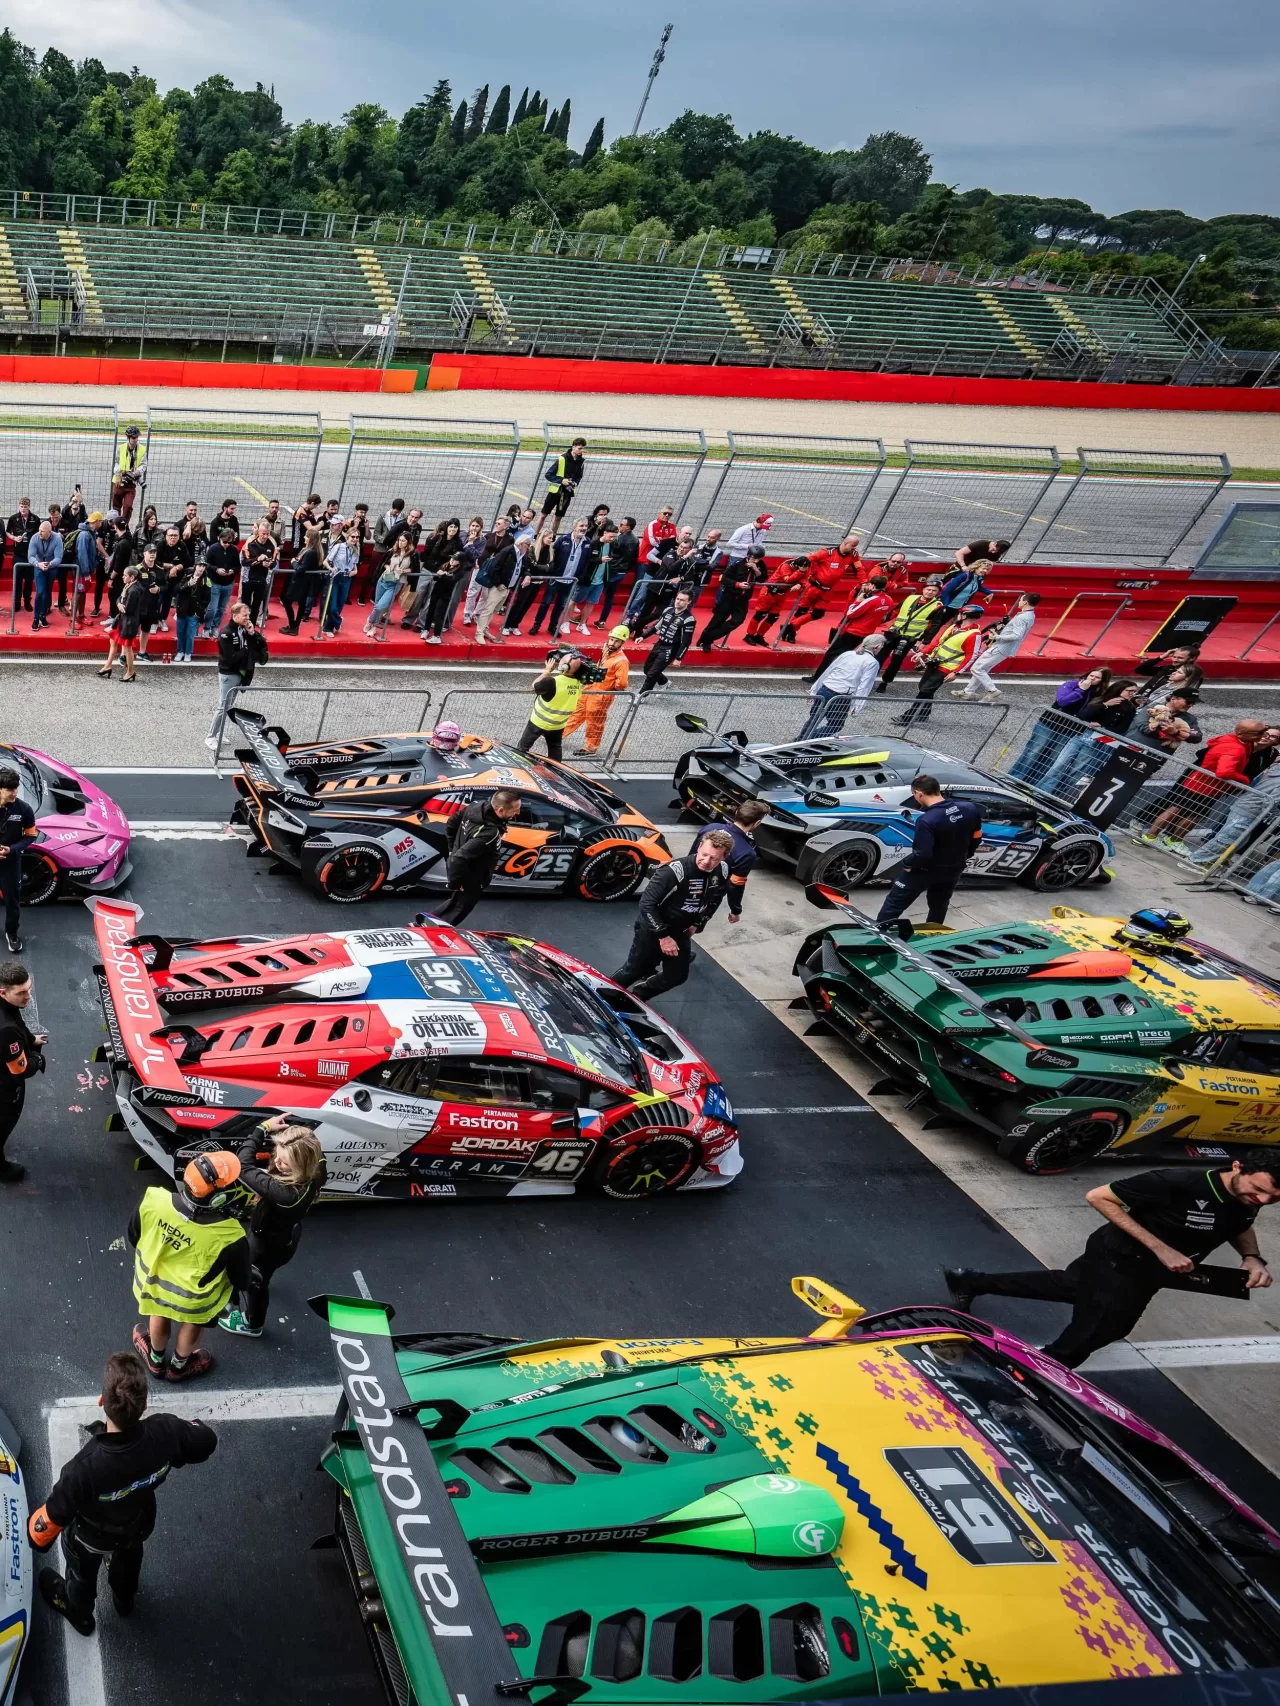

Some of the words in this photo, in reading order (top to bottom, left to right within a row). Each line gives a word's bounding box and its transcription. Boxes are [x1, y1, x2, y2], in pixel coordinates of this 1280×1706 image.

[288, 757, 319, 766] ROGER
[320, 754, 354, 764] DUBUIS
[792, 756, 822, 765] DUBUIS
[1088, 777, 1125, 817] 3
[393, 836, 415, 856] MS
[535, 854, 573, 873] 25
[997, 850, 1032, 868] 32
[68, 868, 98, 877] Fastron
[356, 929, 413, 943] ON-LINE
[95, 911, 153, 1020] randstad
[460, 932, 519, 987] DUBUIS
[421, 961, 463, 996] 46
[985, 965, 1031, 977] DUBUIS
[165, 990, 213, 1003] ROGER
[214, 986, 264, 999] DUBUIS
[97, 974, 128, 1062] XEKUTORBRNO.CZ
[517, 990, 563, 1052] ROGER
[412, 1022, 480, 1039] ON-LINE
[1136, 1030, 1171, 1038] breco
[1041, 1054, 1072, 1068] macron
[183, 1075, 220, 1090] KARNA
[573, 1067, 628, 1093] EXEKUTORBRNO.CZ
[1199, 1078, 1261, 1096] Fastron
[1225, 1075, 1258, 1084] PERTAMINA
[190, 1085, 224, 1105] LINE
[329, 1096, 354, 1108] Stilo
[449, 1112, 519, 1131] Fastron
[483, 1109, 519, 1118] PERTAMINA
[334, 1140, 387, 1151] AQUASYS
[1197, 1146, 1227, 1155] AGRATI
[334, 1155, 377, 1164] ERAM
[409, 1157, 506, 1174] LERAM
[532, 1149, 585, 1172] 46
[424, 1183, 456, 1193] AGRATI
[157, 1218, 192, 1247] MEDIA
[616, 1338, 705, 1349] Fastron
[628, 1348, 673, 1357] PERTAMINA
[916, 1356, 1065, 1506] DUBUIS
[329, 1332, 474, 1639] randstad
[902, 1469, 947, 1524] macron
[10, 1497, 21, 1581] Fastron
[479, 1535, 558, 1551] ROGER
[565, 1526, 650, 1543] DUBUIS
[1073, 1521, 1201, 1672] OGER
